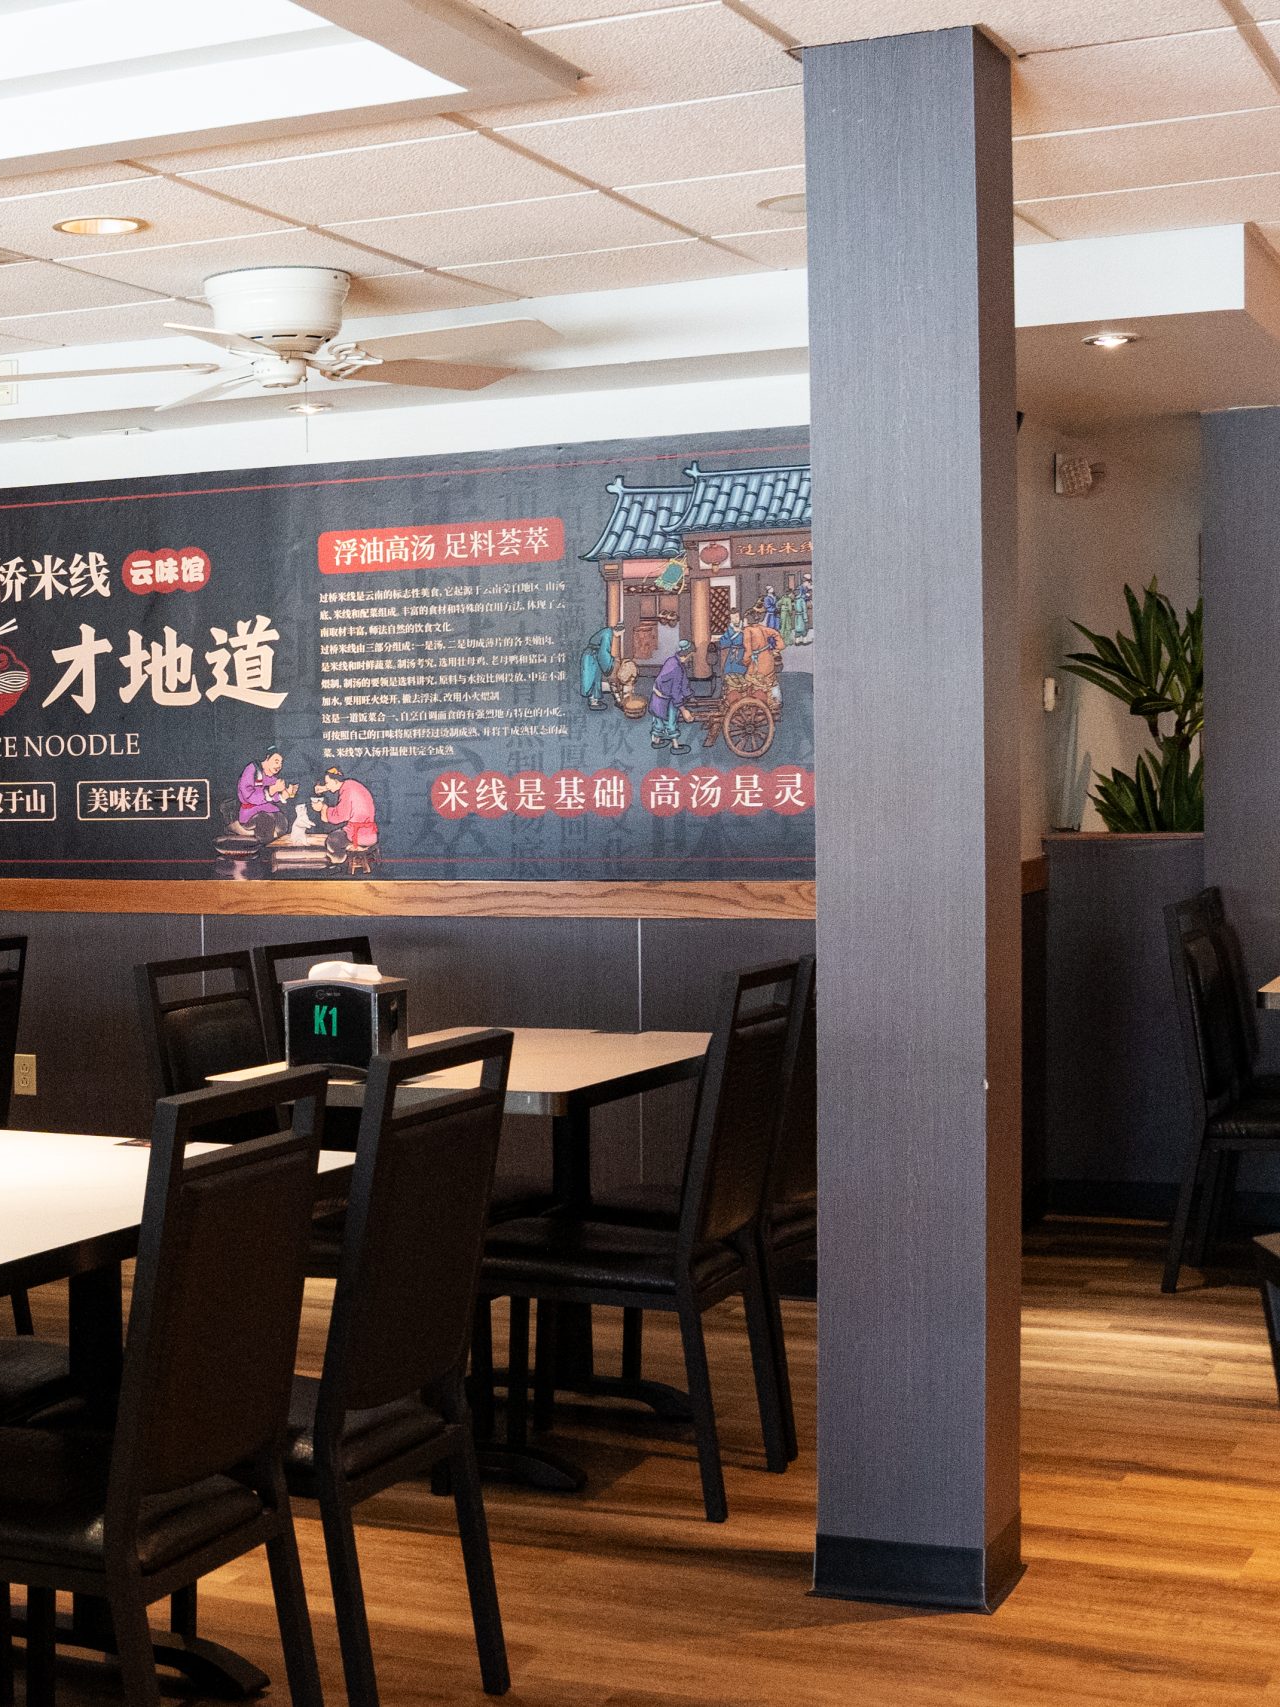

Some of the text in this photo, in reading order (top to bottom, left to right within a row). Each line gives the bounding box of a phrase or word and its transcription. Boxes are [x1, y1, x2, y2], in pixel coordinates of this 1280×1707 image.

[335, 527, 548, 565] 浮油高汤 足料荟萃
[130, 556, 204, 585] 云味馆
[42, 615, 288, 713] 才地道
[24, 733, 140, 756] NOODLE
[88, 787, 199, 812] 美味在于传
[439, 773, 805, 811] 米线是基础 高汤是灵
[314, 1005, 337, 1036] K1
